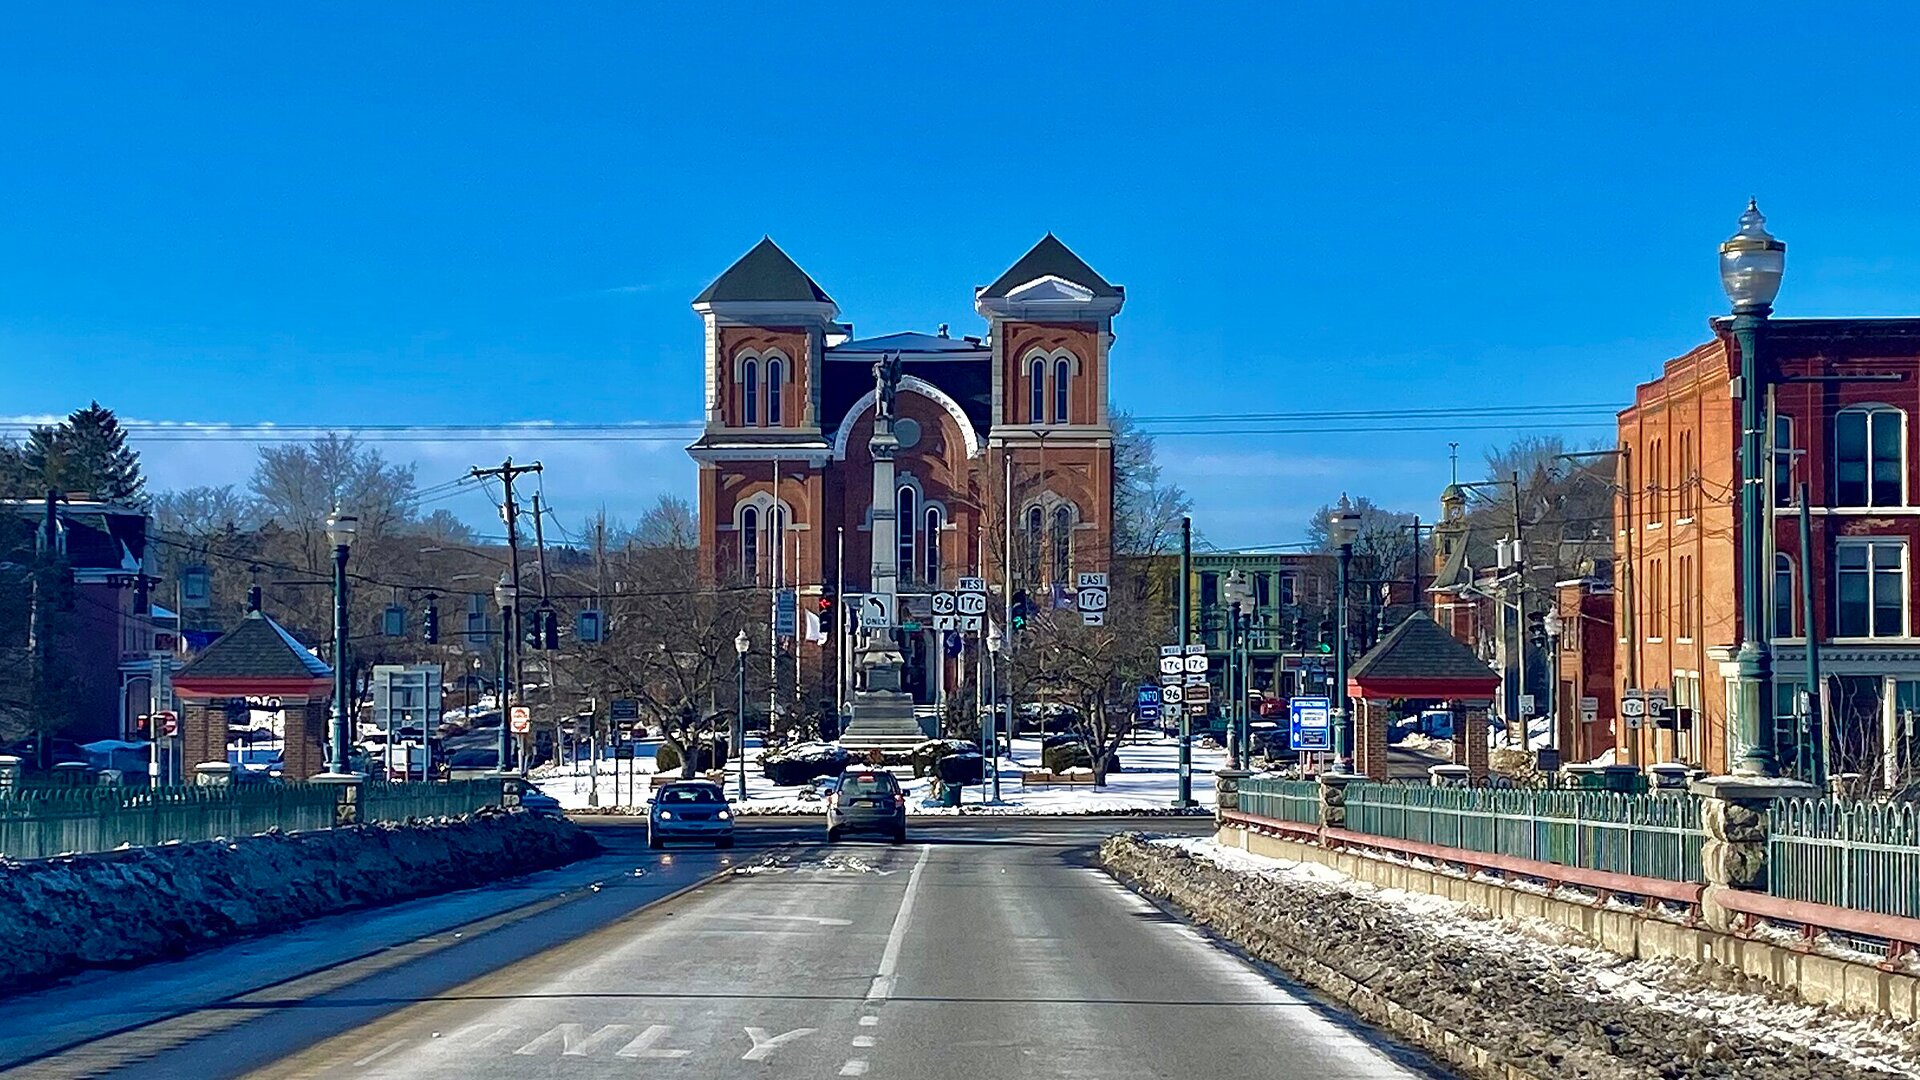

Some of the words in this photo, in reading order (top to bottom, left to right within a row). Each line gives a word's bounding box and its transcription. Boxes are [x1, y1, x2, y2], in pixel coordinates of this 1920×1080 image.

[960, 579, 984, 590] WEST
[1080, 574, 1104, 585] EAST
[934, 596, 953, 611] 96
[960, 596, 983, 611] 17C
[1081, 592, 1104, 606] 17C
[865, 617, 888, 625] ONLY
[1163, 660, 1181, 671] 17C
[1188, 659, 1205, 669] 17C
[1164, 689, 1180, 700] 96
[1520, 705, 1534, 714] 30
[1624, 703, 1641, 713] 17C
